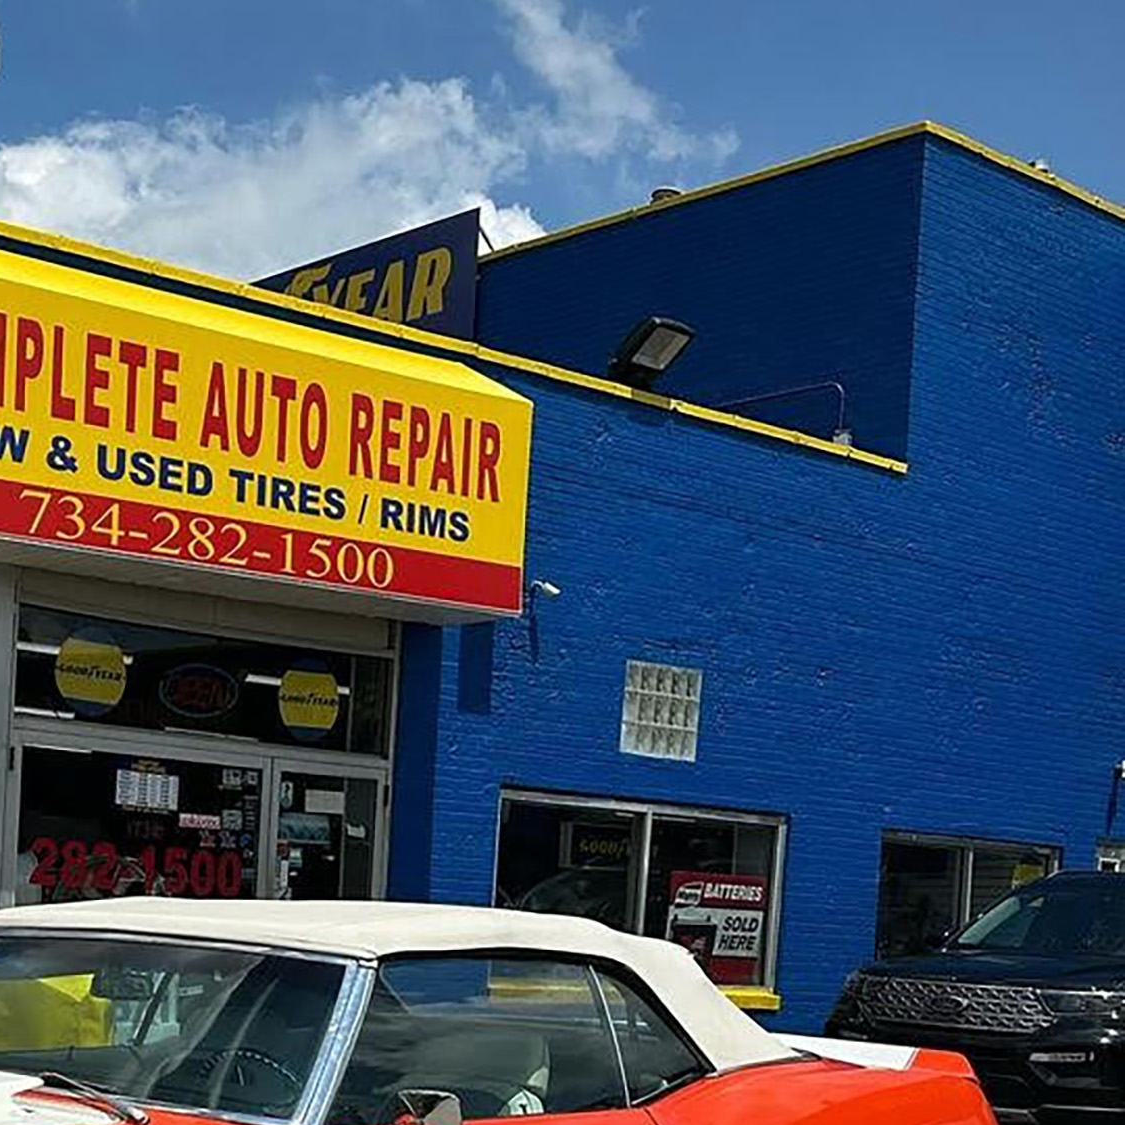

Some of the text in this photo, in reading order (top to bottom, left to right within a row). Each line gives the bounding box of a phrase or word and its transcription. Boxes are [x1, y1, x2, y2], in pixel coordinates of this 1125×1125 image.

[200, 361, 328, 470] AUTO
[348, 393, 501, 503] REPAIR
[46, 436, 78, 473] &
[98, 444, 213, 496] USED
[229, 468, 345, 520] TIRES
[379, 496, 470, 542] RIMS
[18, 488, 395, 590] 734-282-1500
[703, 883, 763, 902] BATTERIES
[718, 935, 757, 950] HERE
[724, 916, 759, 932] SOLD
